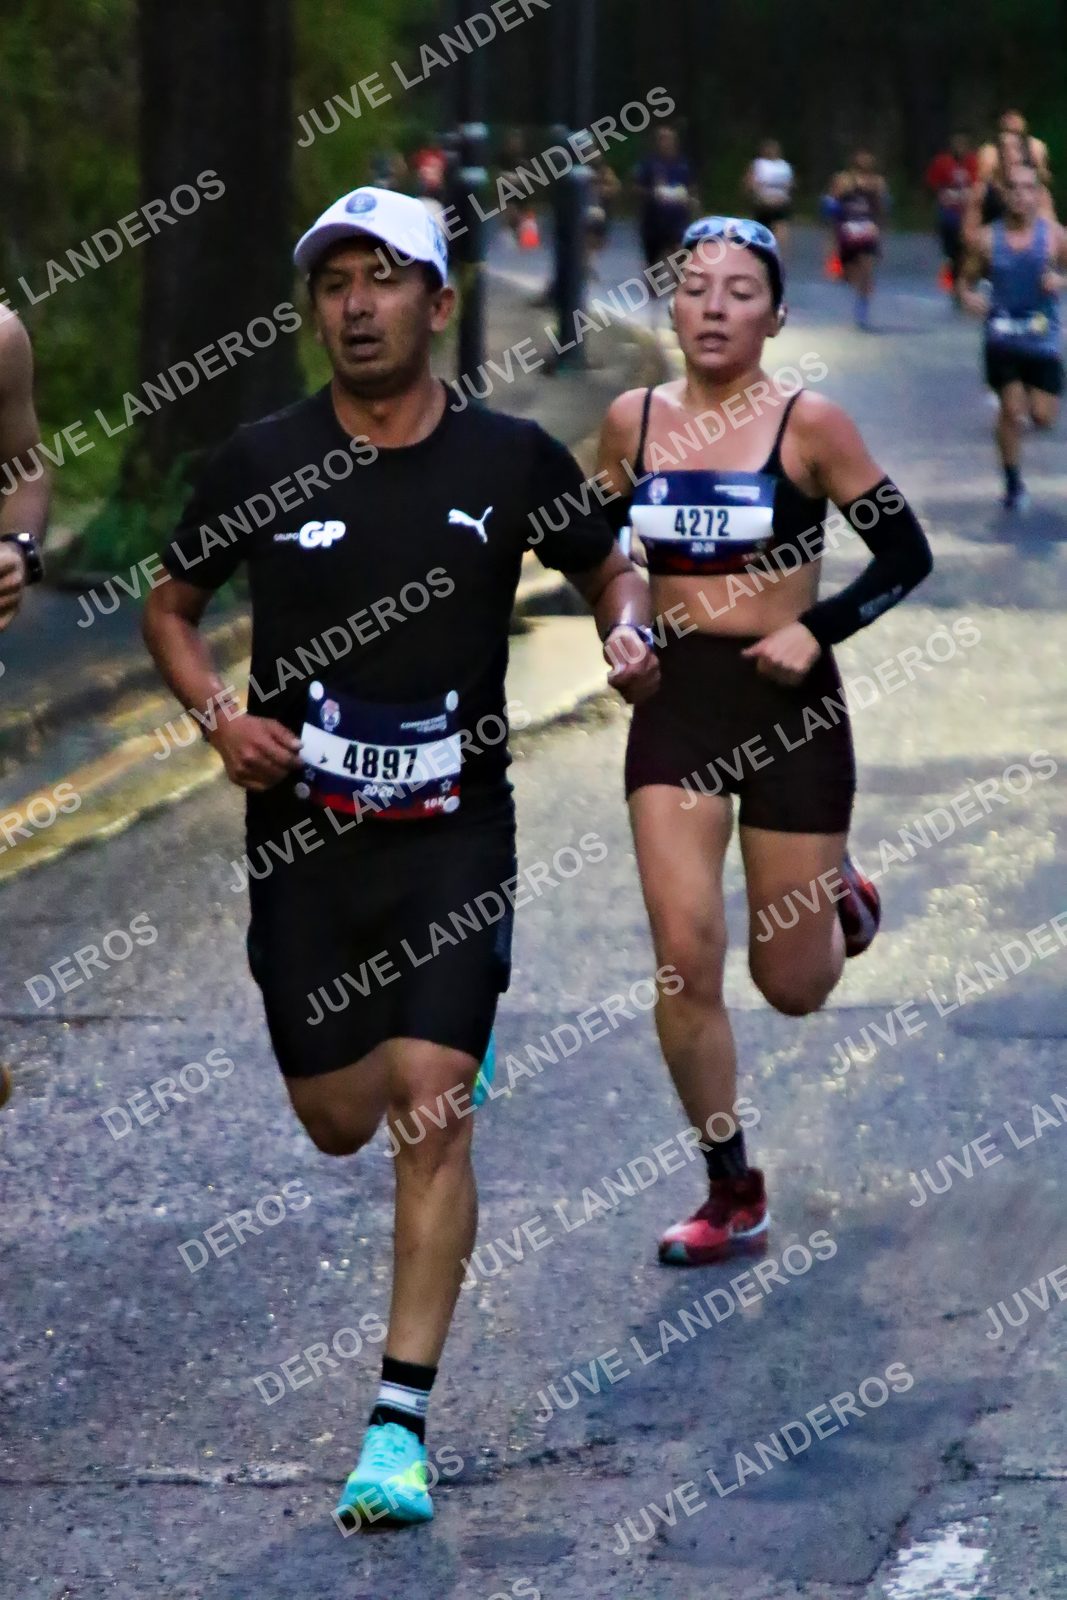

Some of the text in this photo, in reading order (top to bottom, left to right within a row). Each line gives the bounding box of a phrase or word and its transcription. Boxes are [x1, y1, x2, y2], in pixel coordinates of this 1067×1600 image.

[299, 520, 347, 549] GP
[674, 508, 730, 537] 4272
[342, 744, 418, 780] 4897
